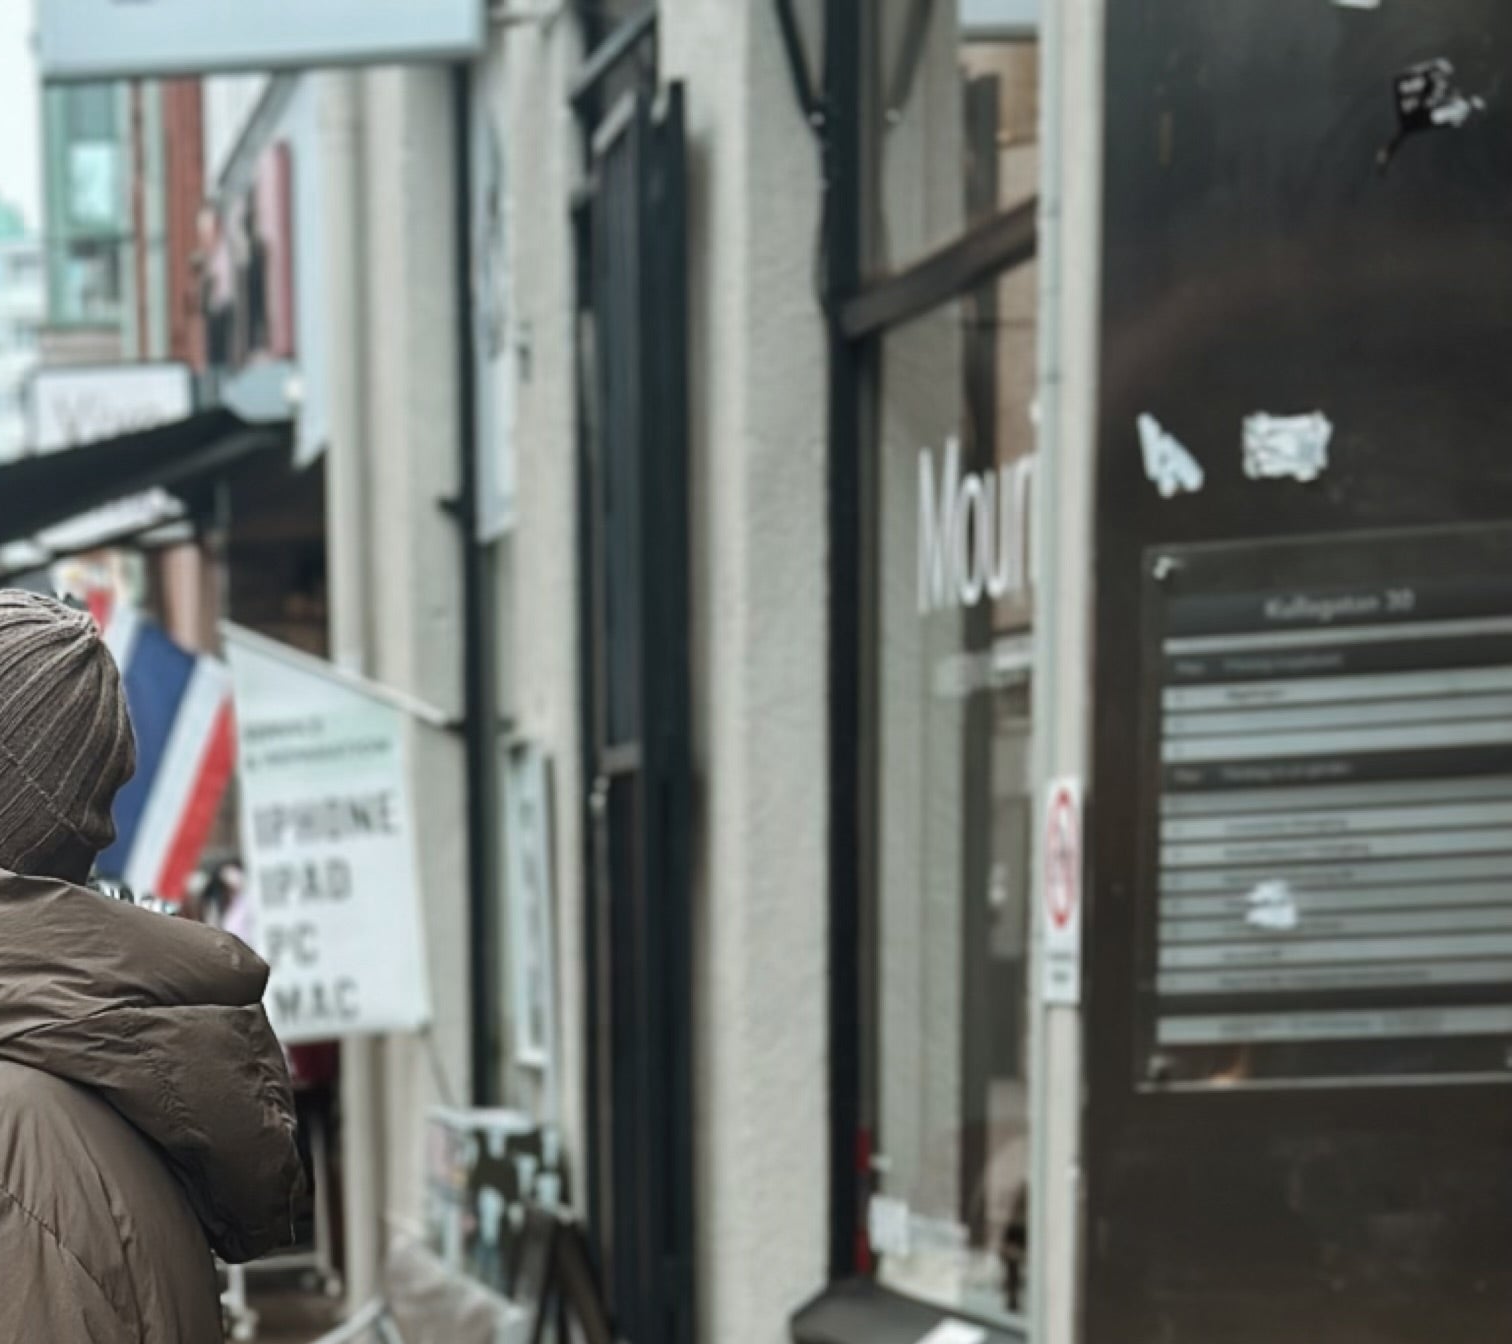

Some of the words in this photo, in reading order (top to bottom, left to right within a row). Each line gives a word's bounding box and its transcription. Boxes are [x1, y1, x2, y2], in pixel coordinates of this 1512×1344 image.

[254, 789, 399, 849] IPHONE
[260, 858, 352, 910] IPAD
[266, 920, 320, 971] PC
[273, 976, 360, 1022] MAC
